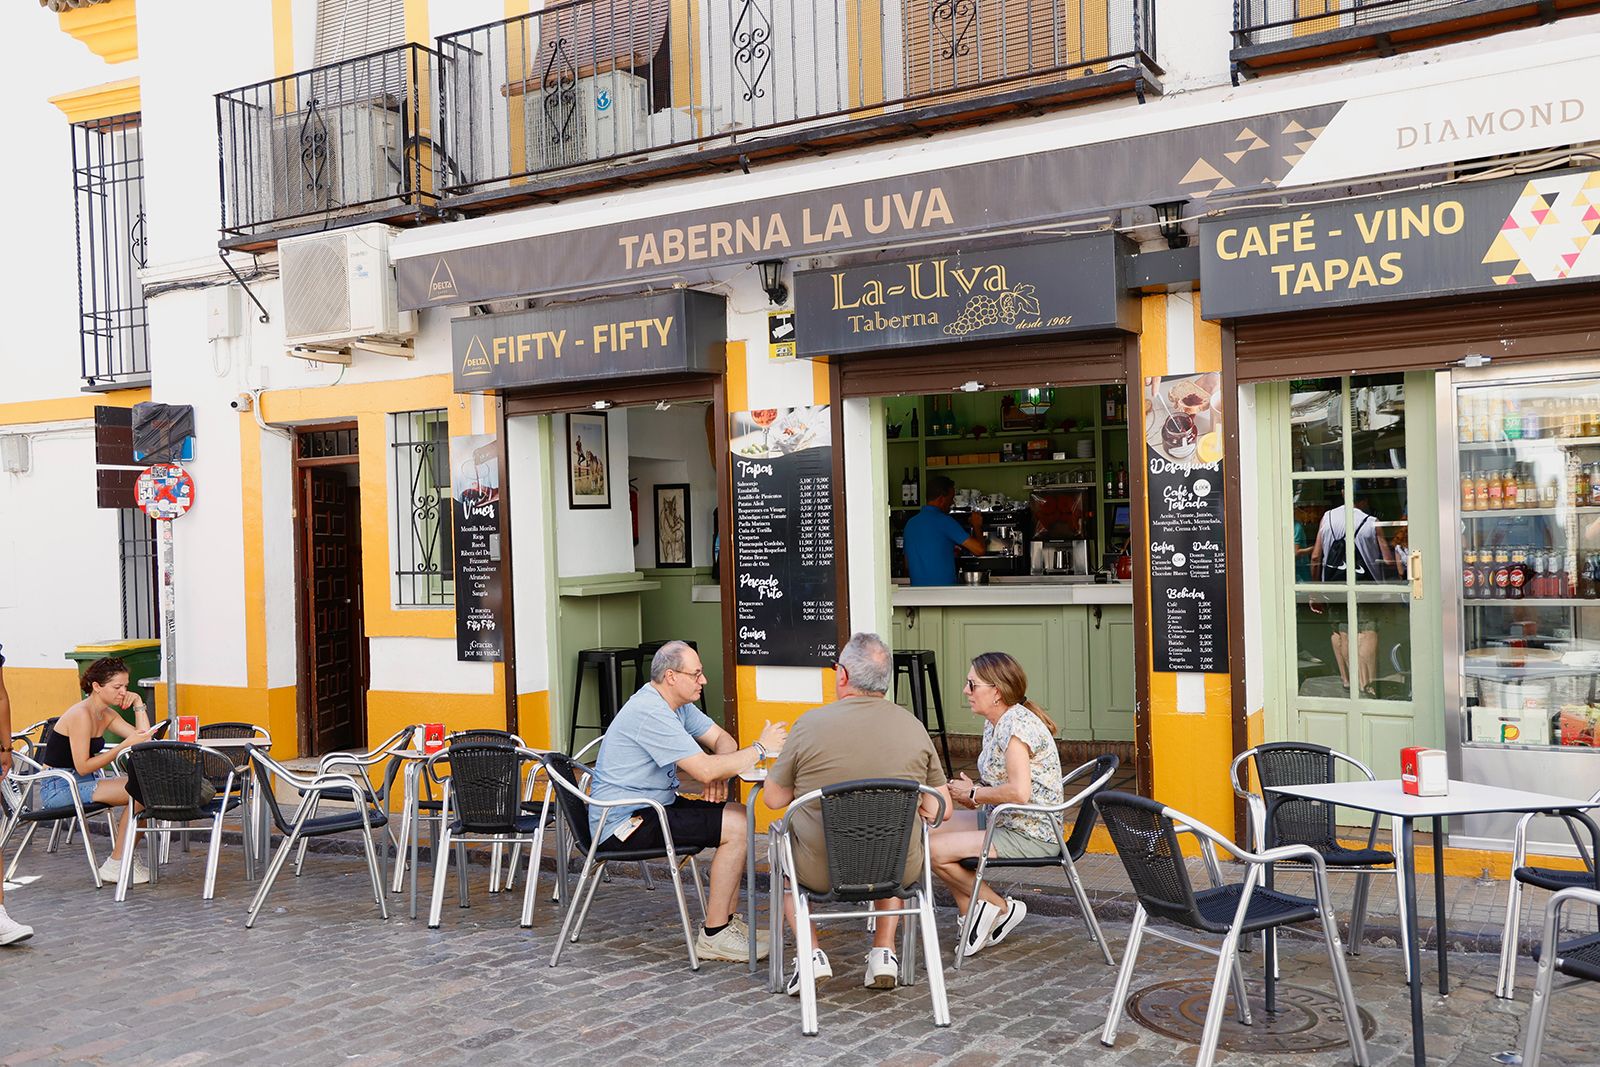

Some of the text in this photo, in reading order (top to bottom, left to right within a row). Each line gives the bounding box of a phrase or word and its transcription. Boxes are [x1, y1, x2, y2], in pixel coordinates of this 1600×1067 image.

[1396, 98, 1584, 150] DIAMOND
[618, 187, 955, 270] TABERNA LA UVA
[1216, 214, 1316, 261] CAFÉ
[1354, 201, 1464, 244] VINO
[1271, 252, 1403, 296] TAPAS
[433, 281, 452, 290] DELTA
[831, 259, 1010, 311] La-Uva
[848, 310, 939, 333] Taberna
[1016, 316, 1072, 330] desde 1964
[492, 329, 567, 365] FIFTY
[593, 316, 673, 353] FIFTY
[468, 358, 486, 366] DELTA
[737, 461, 773, 478] Tapas
[1151, 458, 1219, 477] Desayunos
[1164, 485, 1188, 500] Café
[463, 499, 495, 520] Vinos
[1164, 497, 1208, 511] Tostada
[1151, 541, 1175, 554] Gofres
[1192, 541, 1219, 551] Dulces
[740, 573, 779, 588] Pescado
[758, 585, 783, 600] Frito
[1166, 587, 1205, 600] Bebidas
[740, 626, 766, 640] Guisos
